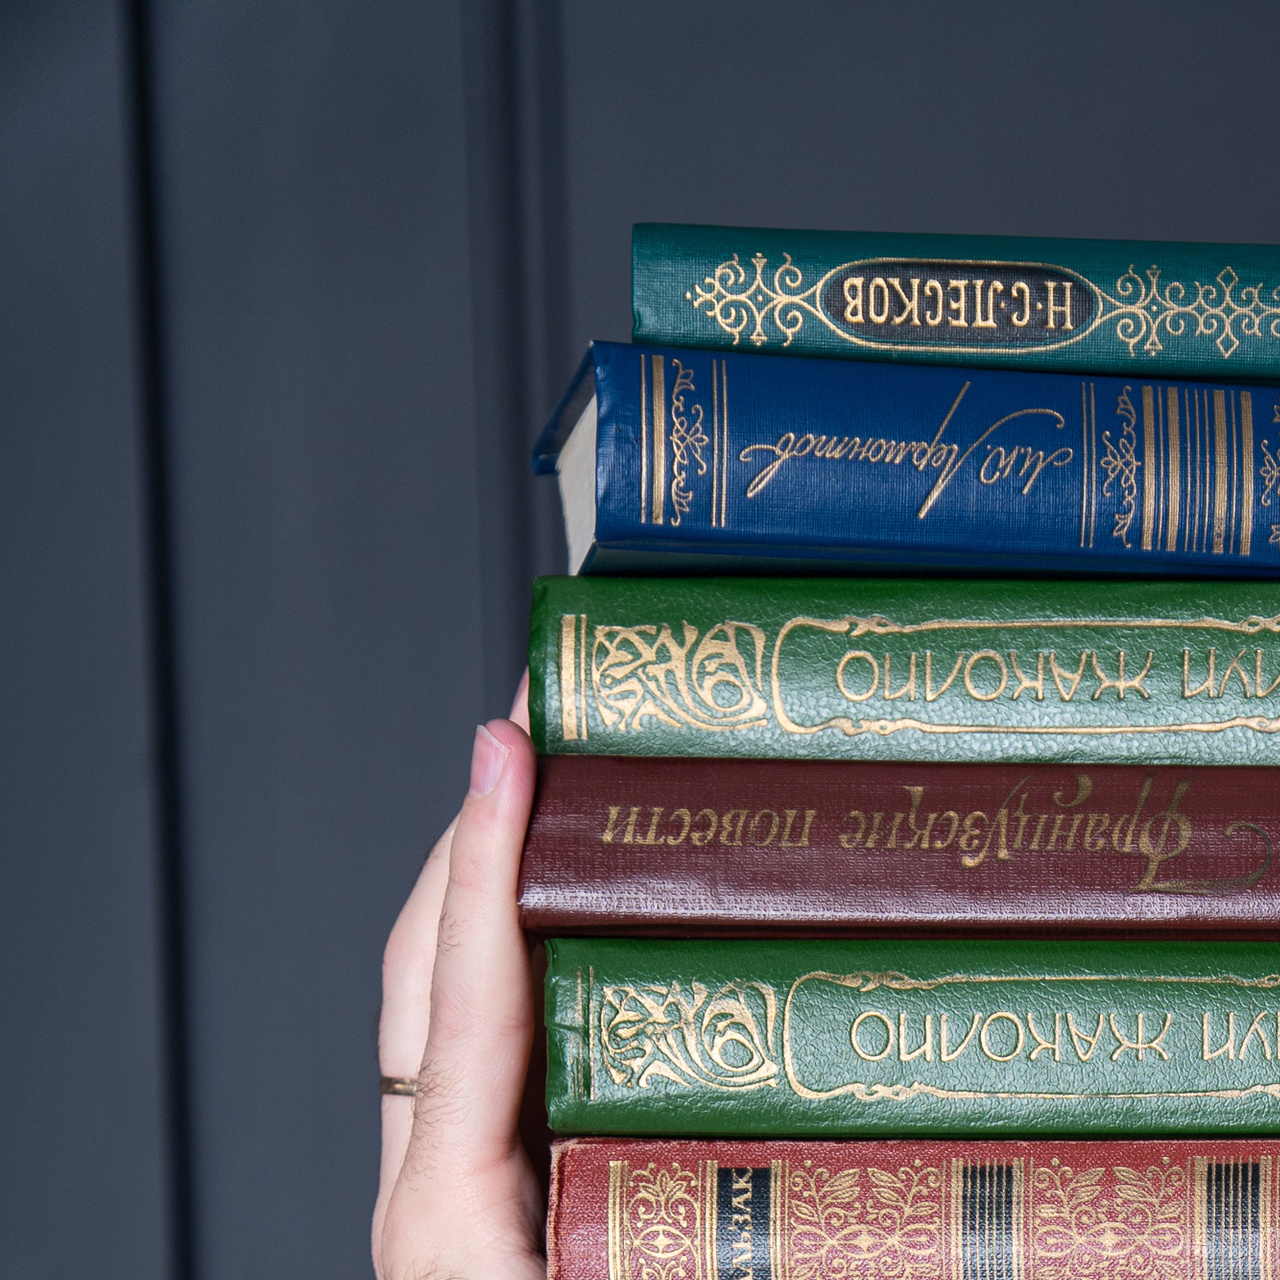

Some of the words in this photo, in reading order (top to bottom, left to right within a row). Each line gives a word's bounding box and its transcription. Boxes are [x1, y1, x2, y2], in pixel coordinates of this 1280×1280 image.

[738, 380, 1066, 520] Лермонтов
[601, 804, 818, 849] повести
[838, 773, 1273, 896] Французские
